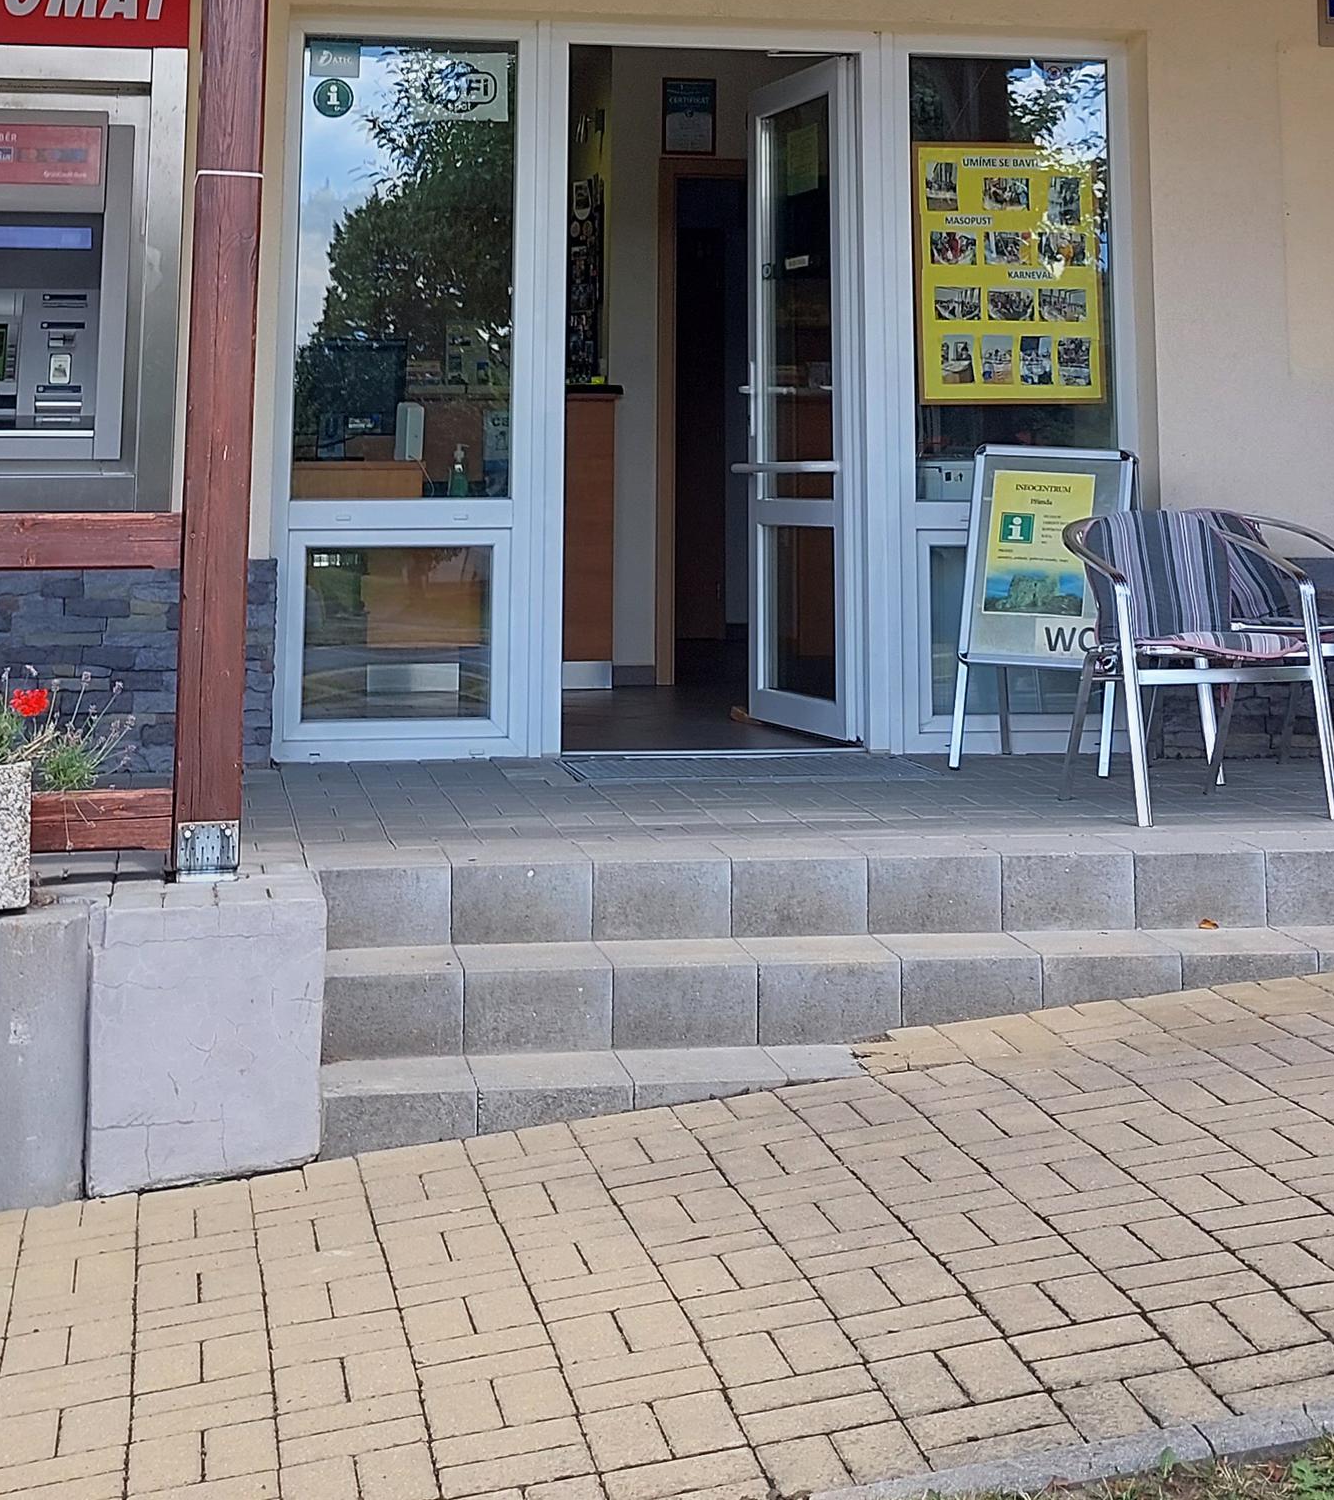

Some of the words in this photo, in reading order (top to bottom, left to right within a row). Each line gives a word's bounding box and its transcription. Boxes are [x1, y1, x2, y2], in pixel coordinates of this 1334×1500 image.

[963, 156, 996, 167] UMÍME
[999, 158, 1009, 167] SE
[945, 216, 992, 225] MASOPUST
[1045, 626, 1097, 652] WC
